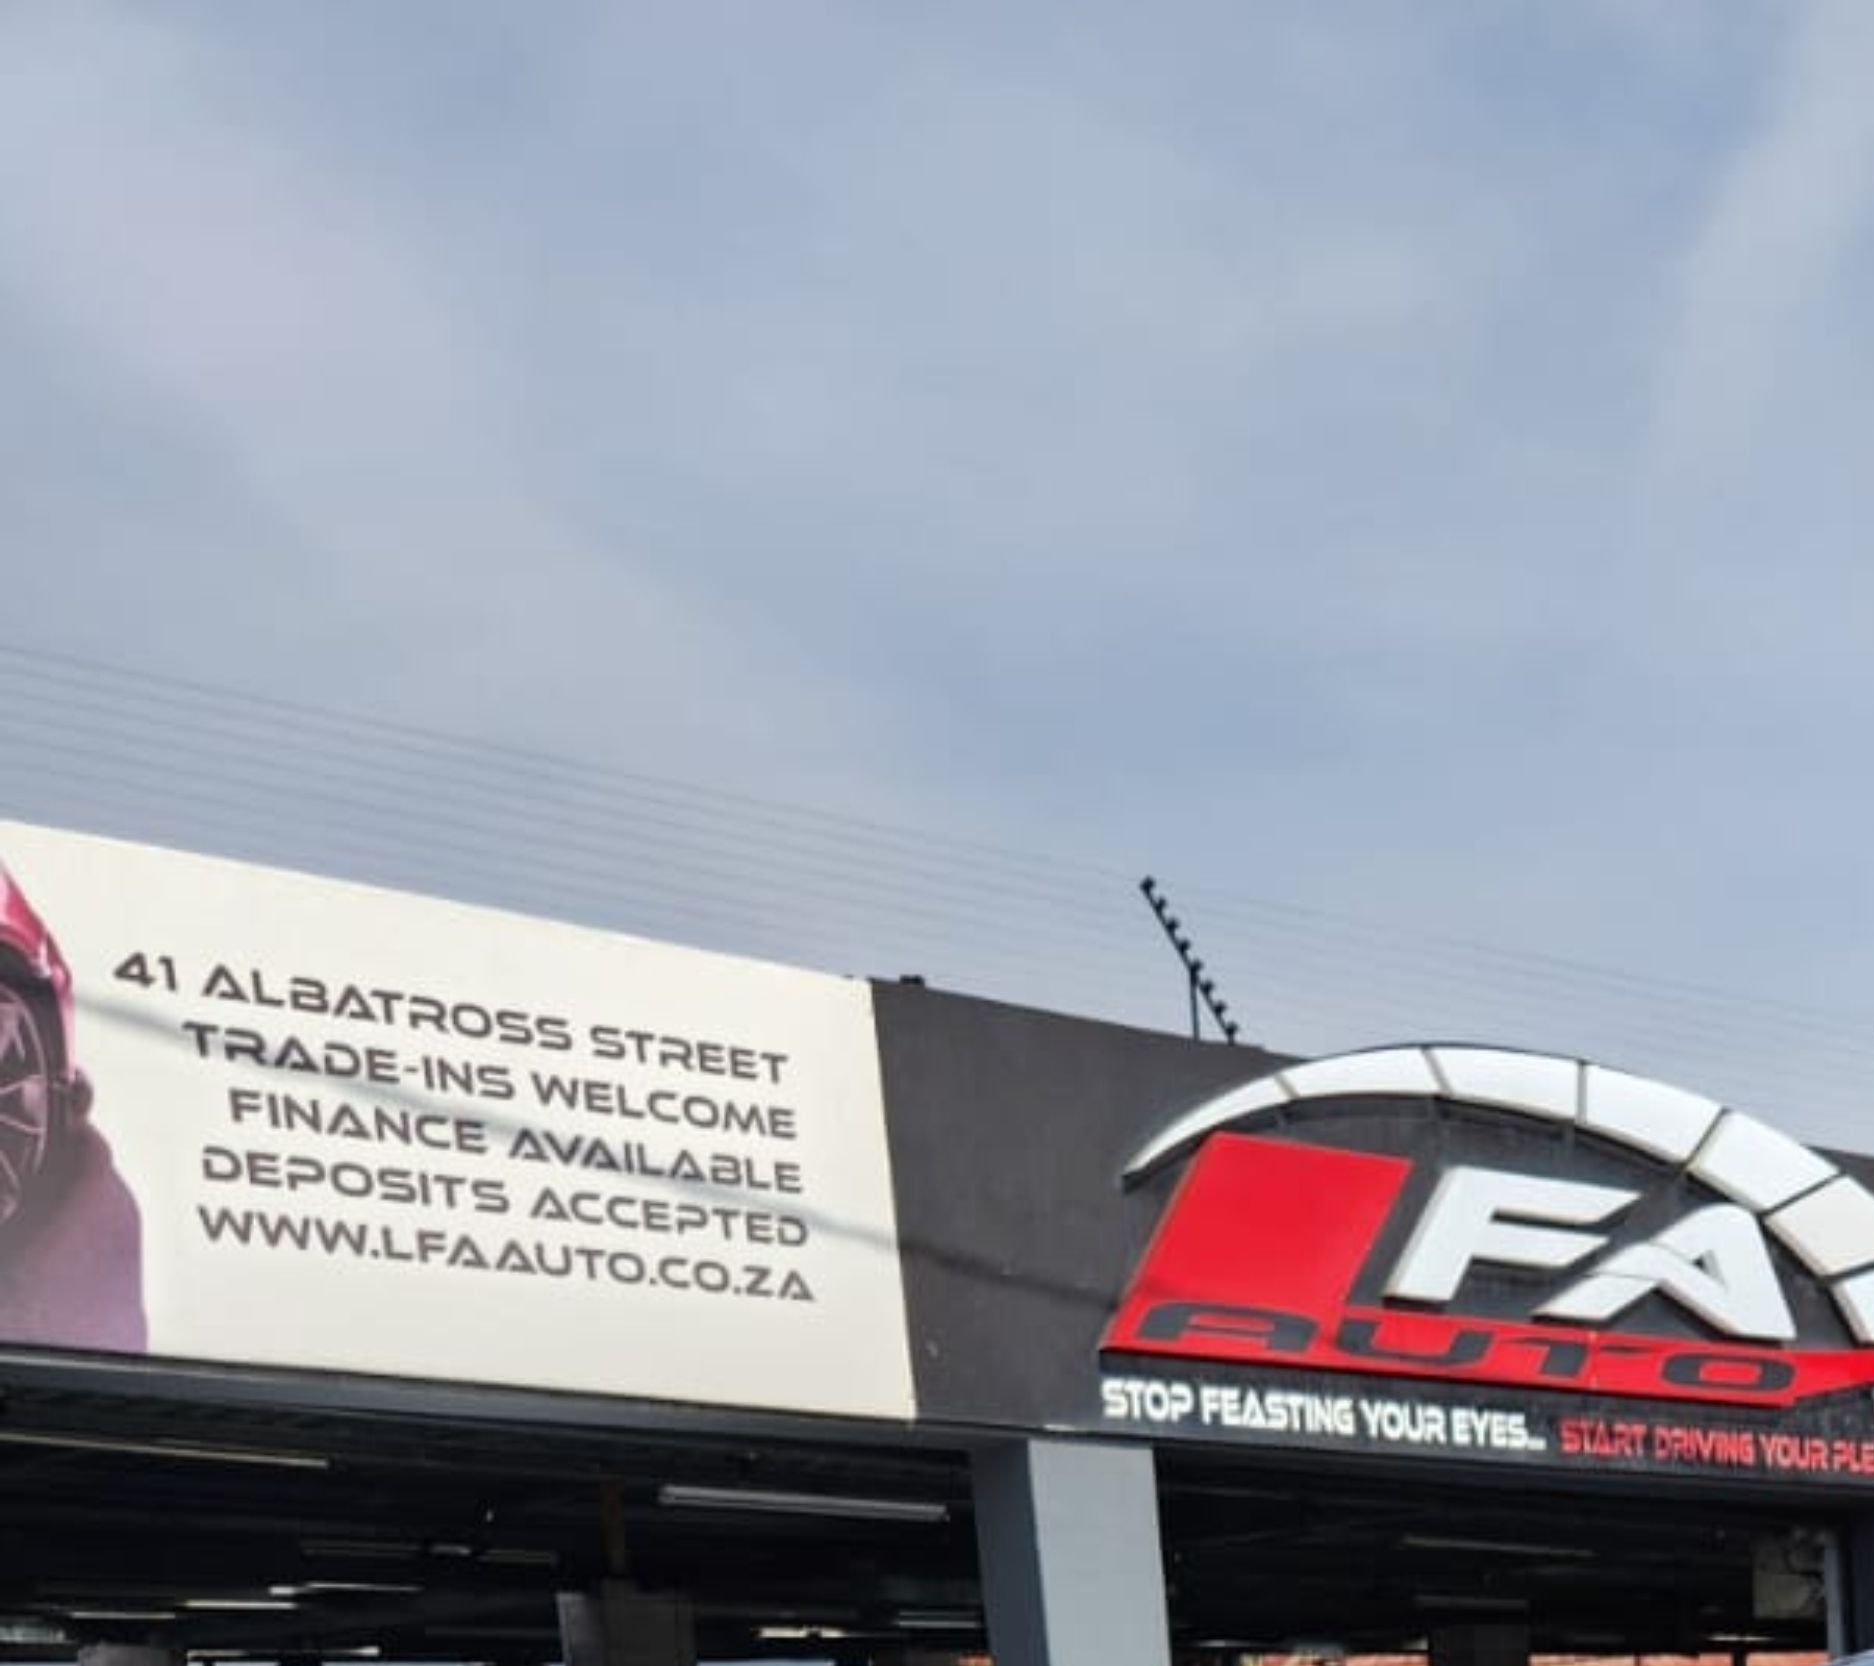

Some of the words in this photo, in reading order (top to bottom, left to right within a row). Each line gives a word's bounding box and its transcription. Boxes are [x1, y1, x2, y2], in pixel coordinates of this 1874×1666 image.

[114, 952, 177, 991] 41
[202, 965, 572, 1050] ALBATROSS
[590, 1025, 788, 1084] STREET
[181, 1021, 514, 1100] TRADE-INS
[532, 1073, 797, 1140] WELCOME
[229, 1088, 488, 1154] FINANCE
[509, 1128, 802, 1194] AVAILABLE
[203, 1146, 509, 1213] DEPOSITS
[531, 1188, 808, 1247] ACCEPTED
[198, 1206, 814, 1301] WWW.LFAAUTO.CO.ZA
[1137, 1302, 1798, 1394] AUTO
[1101, 1379, 1193, 1419] STOP
[1201, 1386, 1355, 1436] FEASTING
[1358, 1402, 1446, 1443] YOUR
[1561, 1420, 1648, 1457] START
[1656, 1426, 1754, 1468] DRIVING
[1758, 1432, 1828, 1471] YOUR
